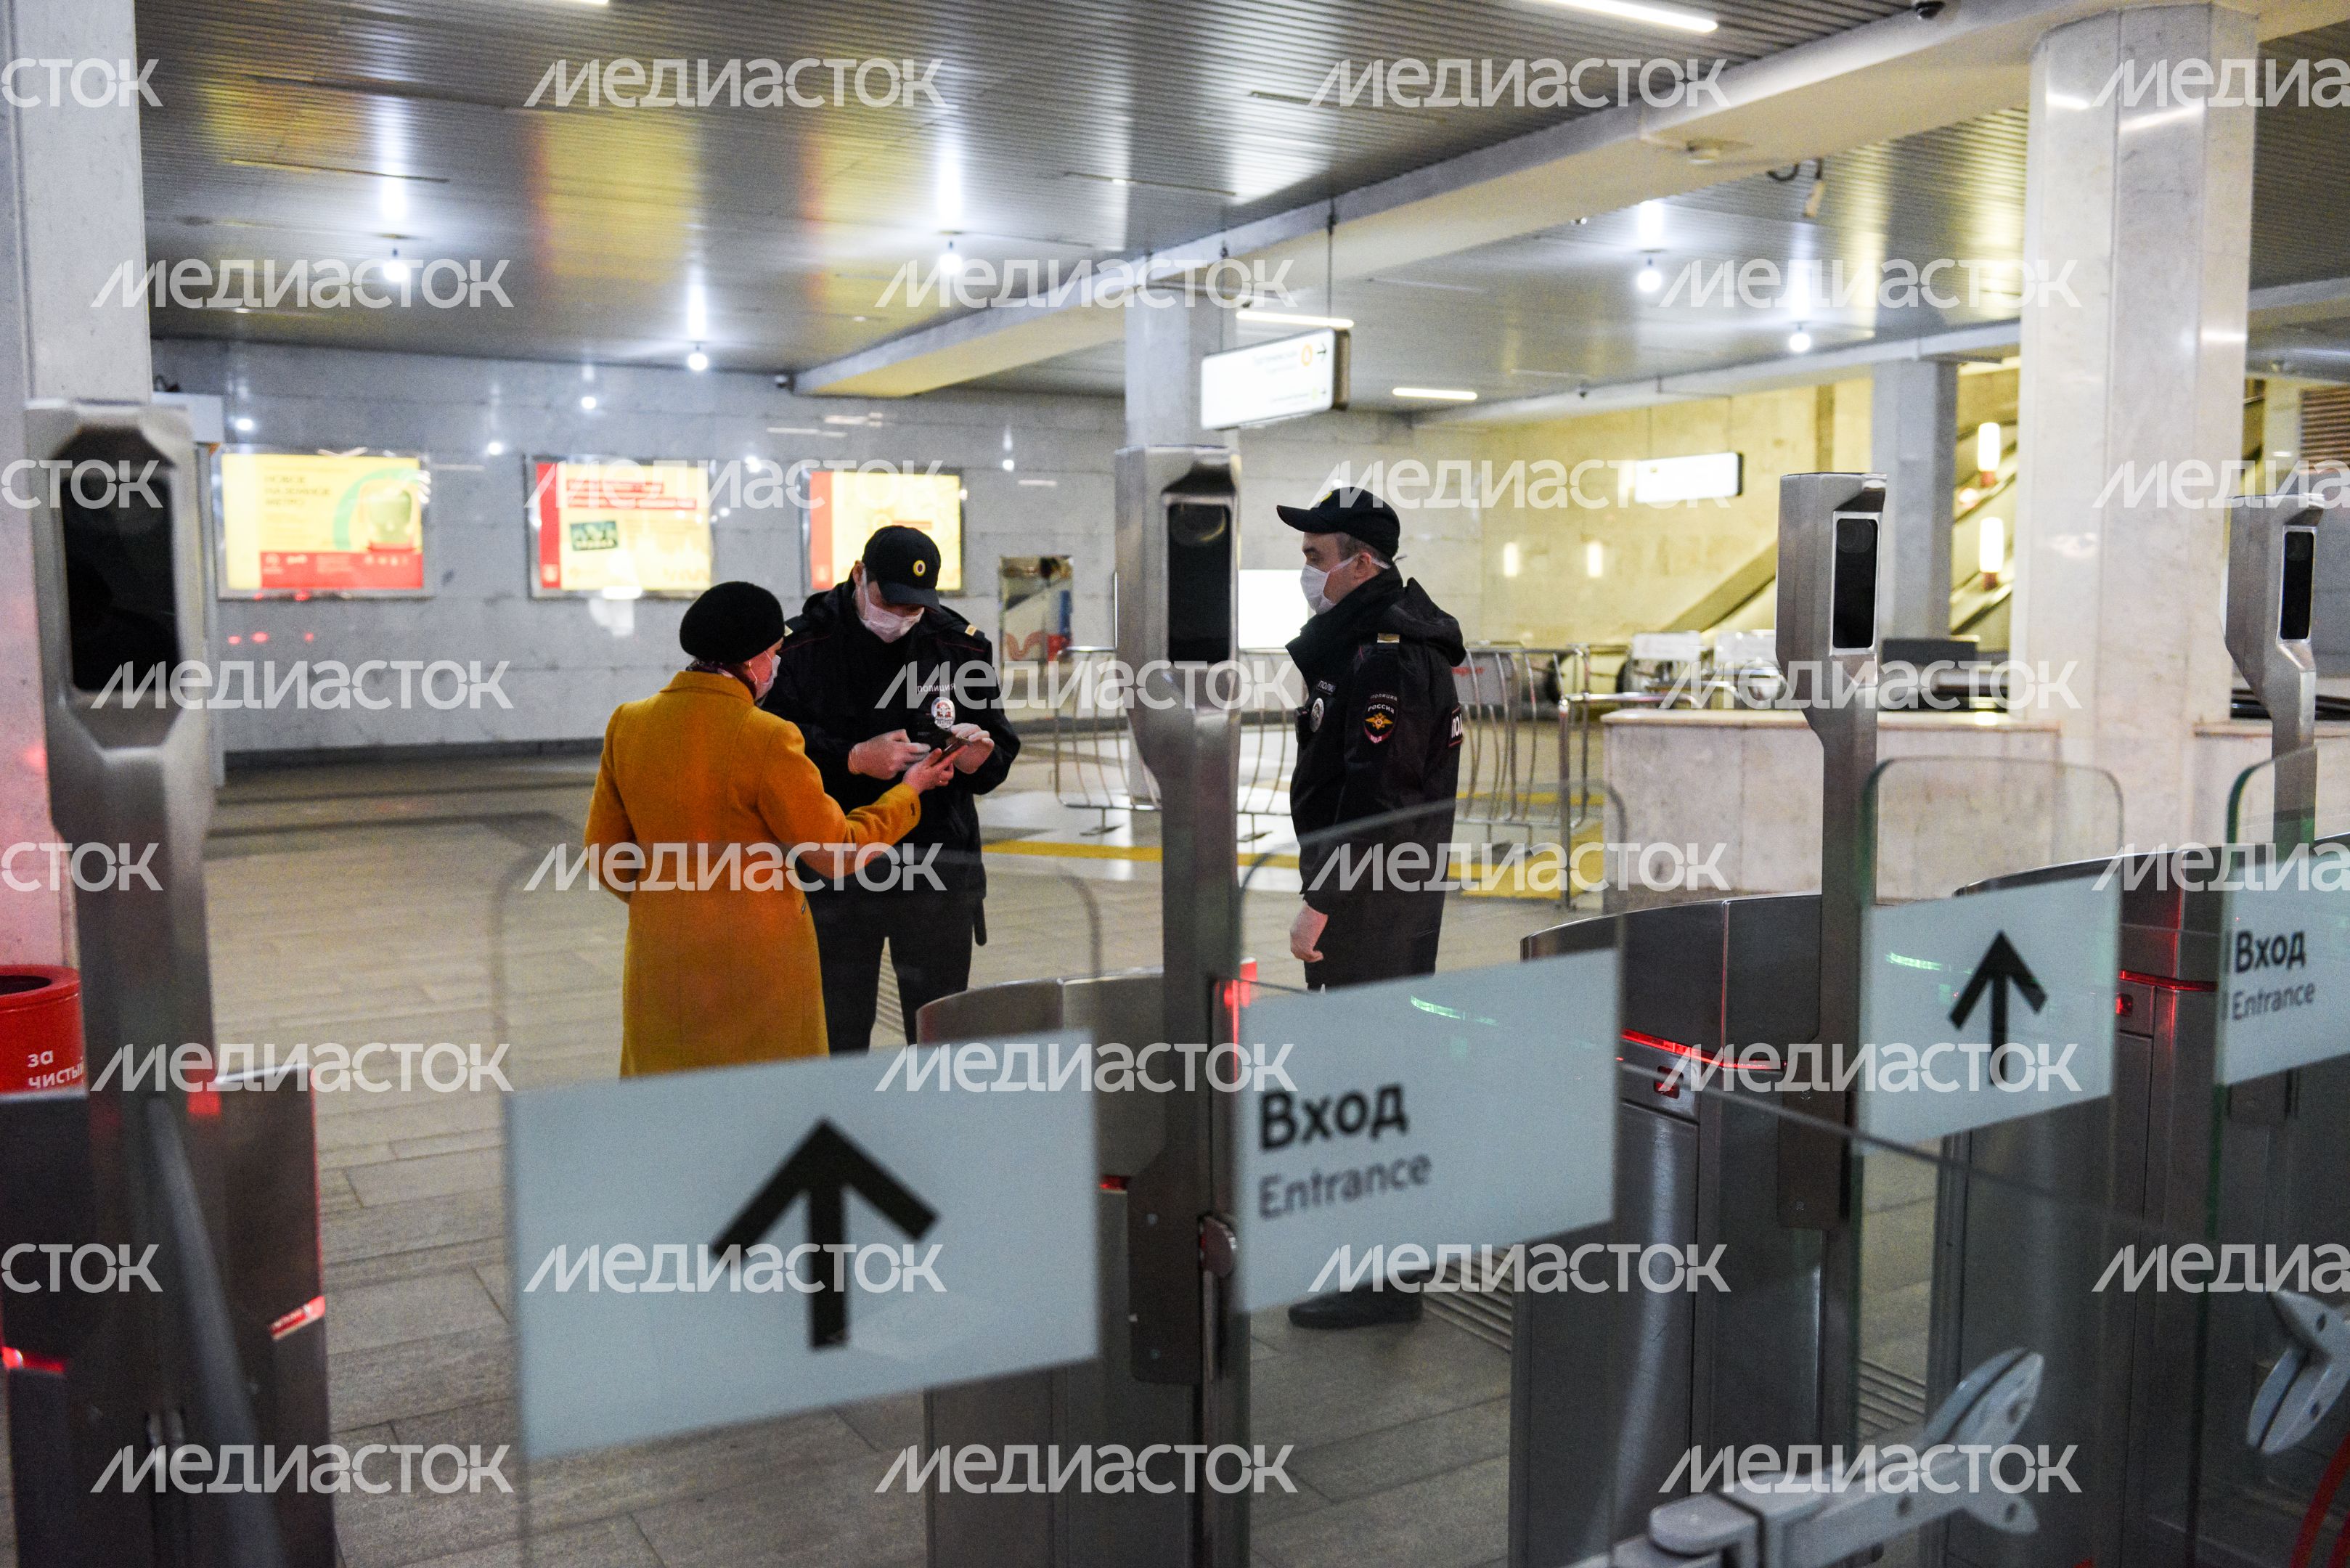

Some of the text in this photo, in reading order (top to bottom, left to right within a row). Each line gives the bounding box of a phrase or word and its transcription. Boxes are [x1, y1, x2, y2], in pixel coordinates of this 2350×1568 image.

[917, 683, 956, 693] ПОЛИЦИЯ
[1370, 693, 1398, 702] ПОЛИЦИЯ
[1367, 703, 1395, 714] РОССИЯ
[2235, 931, 2306, 973] Вход
[2232, 982, 2316, 1021] Entrance
[28, 1050, 54, 1068] за
[1260, 1082, 1408, 1150] Вход
[1259, 1154, 1431, 1220] Entrance
